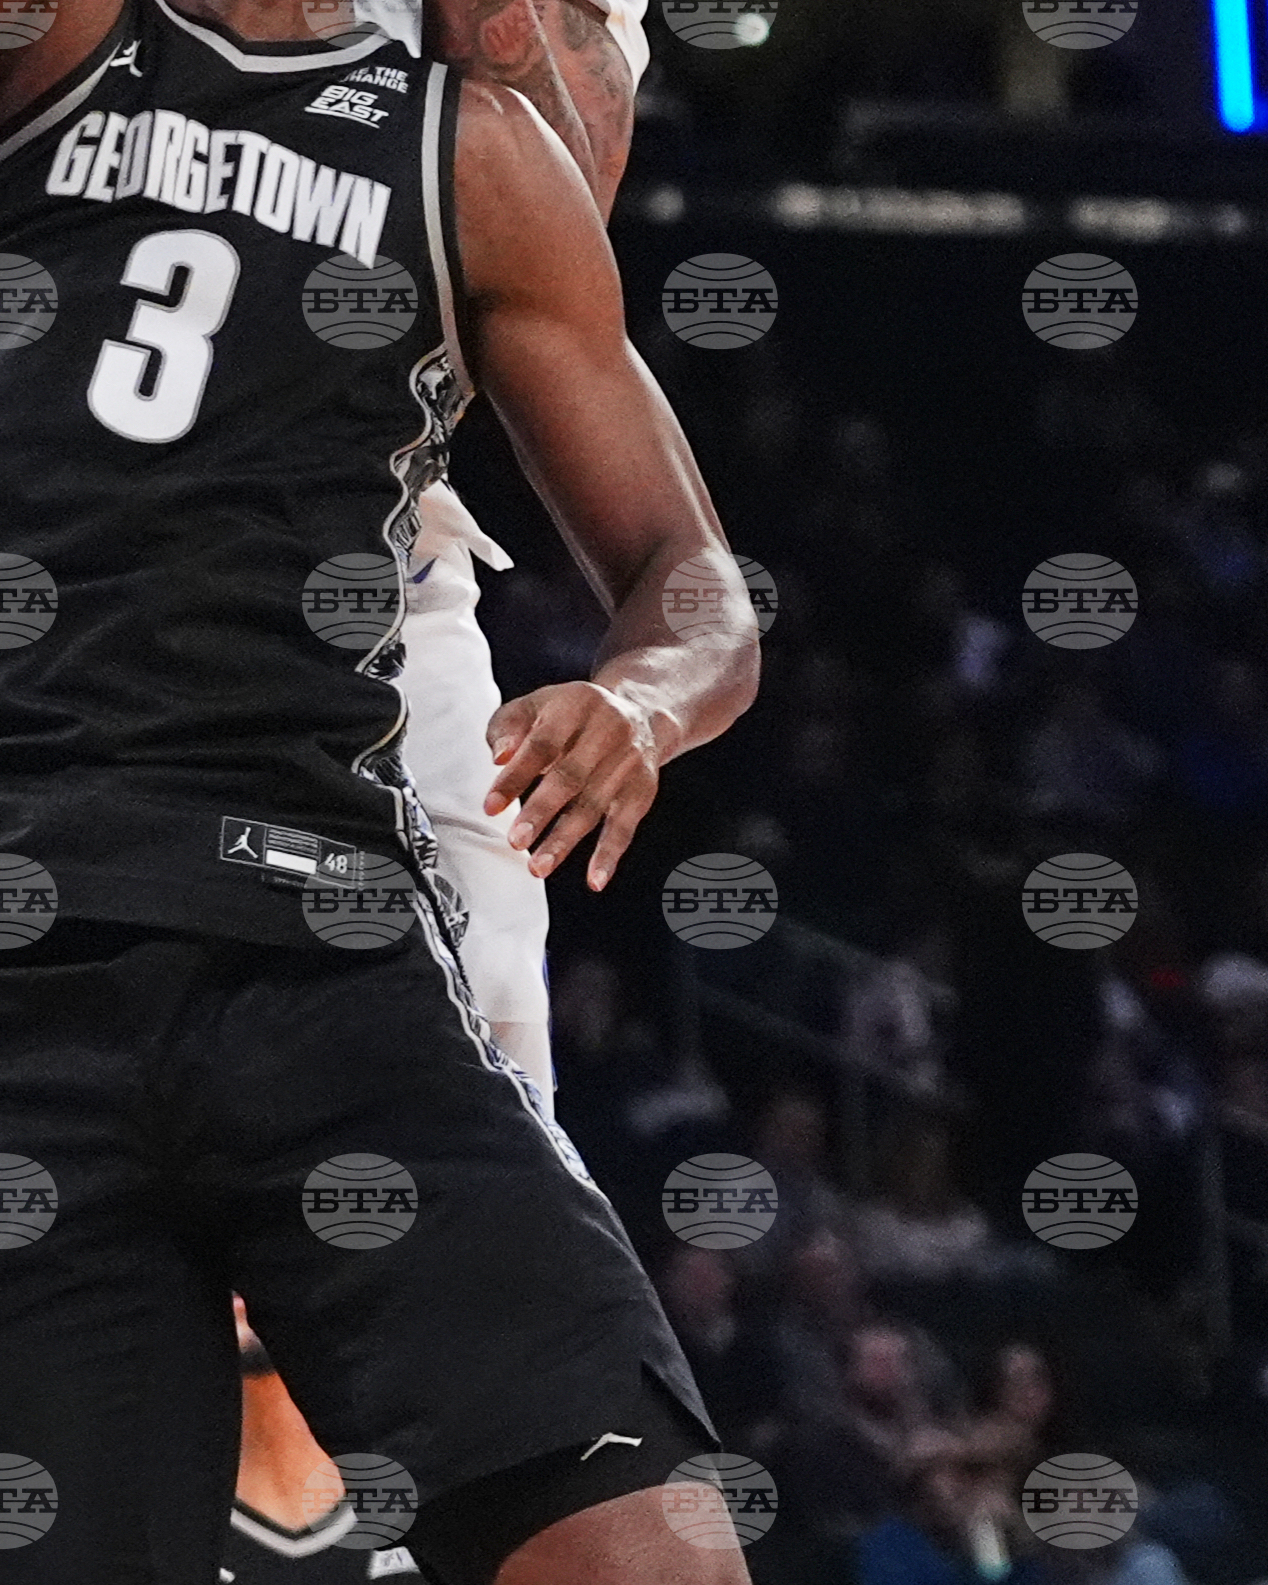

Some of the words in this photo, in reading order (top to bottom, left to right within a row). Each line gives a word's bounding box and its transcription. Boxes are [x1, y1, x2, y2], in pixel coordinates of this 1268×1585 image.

[374, 66, 409, 83] THE
[320, 84, 380, 107] BIG
[310, 96, 390, 123] EAST
[45, 108, 393, 271] GEORGETOWN
[86, 227, 242, 445] 3
[324, 852, 348, 874] 48
